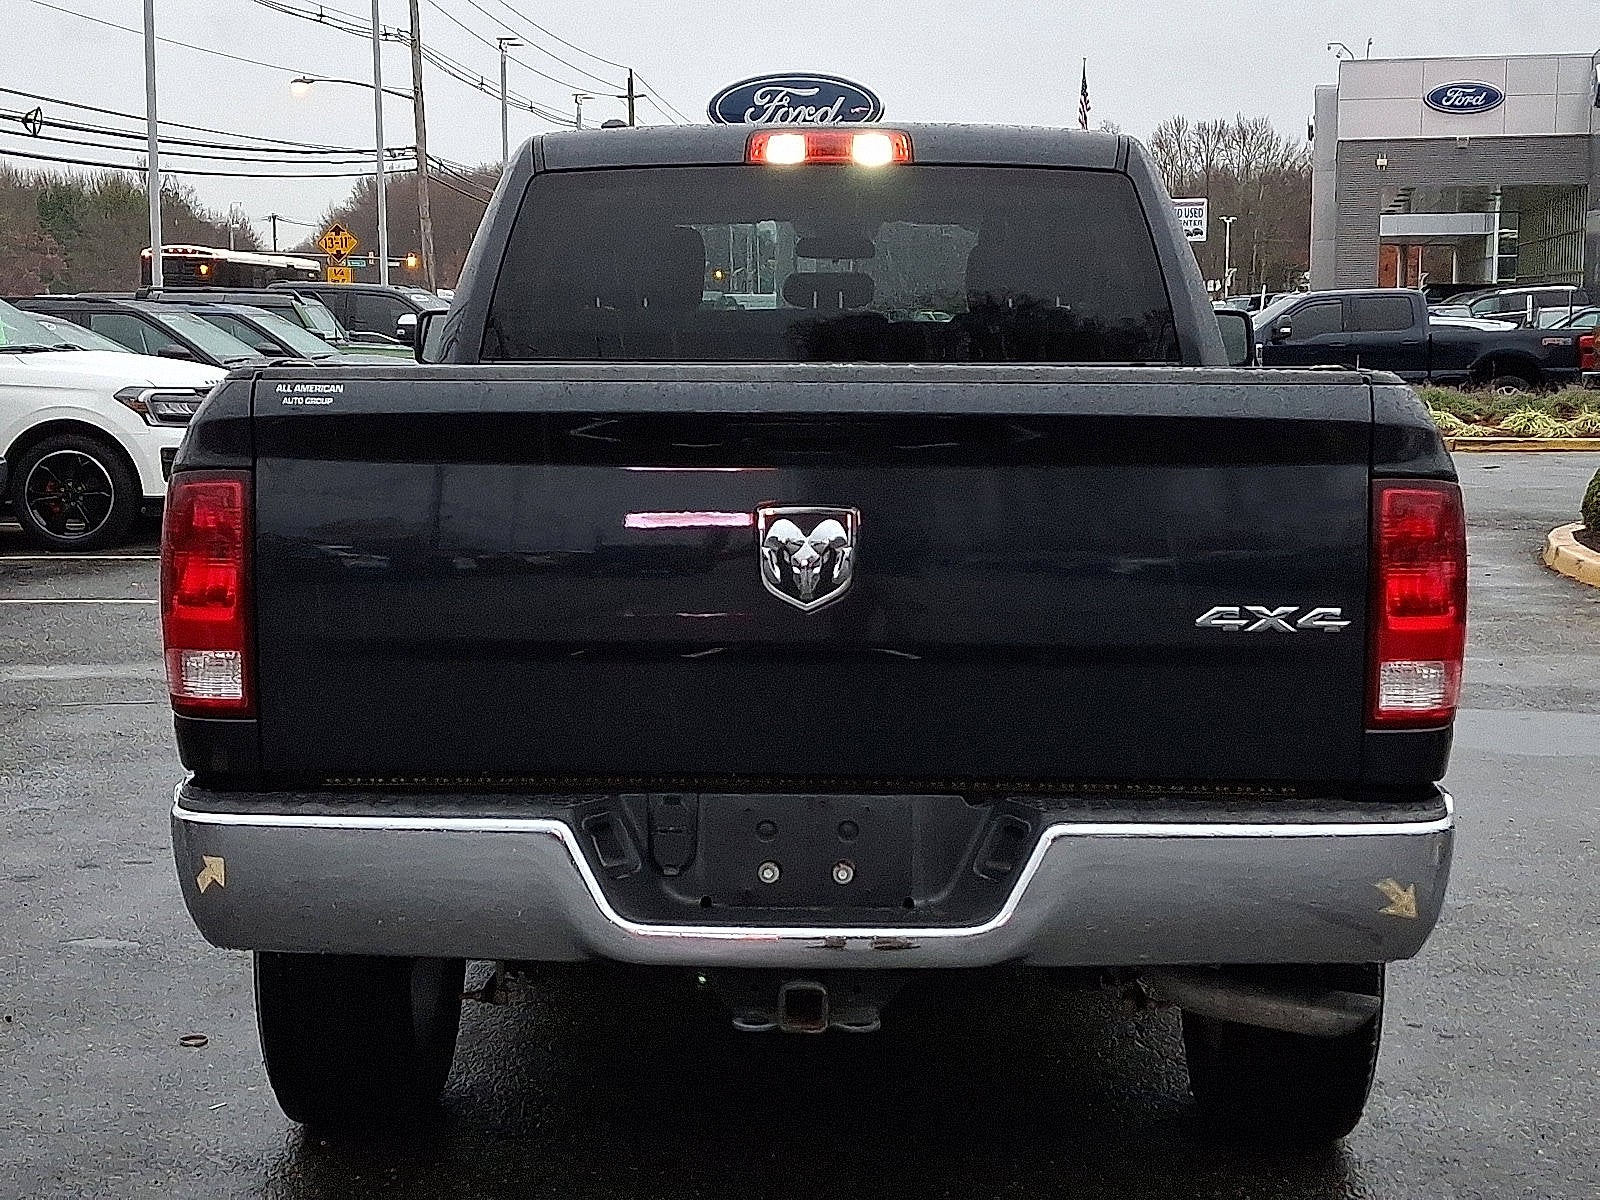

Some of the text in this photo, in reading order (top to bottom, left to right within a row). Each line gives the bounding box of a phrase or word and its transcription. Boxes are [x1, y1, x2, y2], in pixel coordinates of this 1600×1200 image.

[1441, 87, 1487, 106] Ford
[744, 86, 846, 124] Ford
[1184, 207, 1204, 218] USED
[275, 383, 344, 393] ALL AMERICAN
[282, 396, 334, 405] AUTO GROUP
